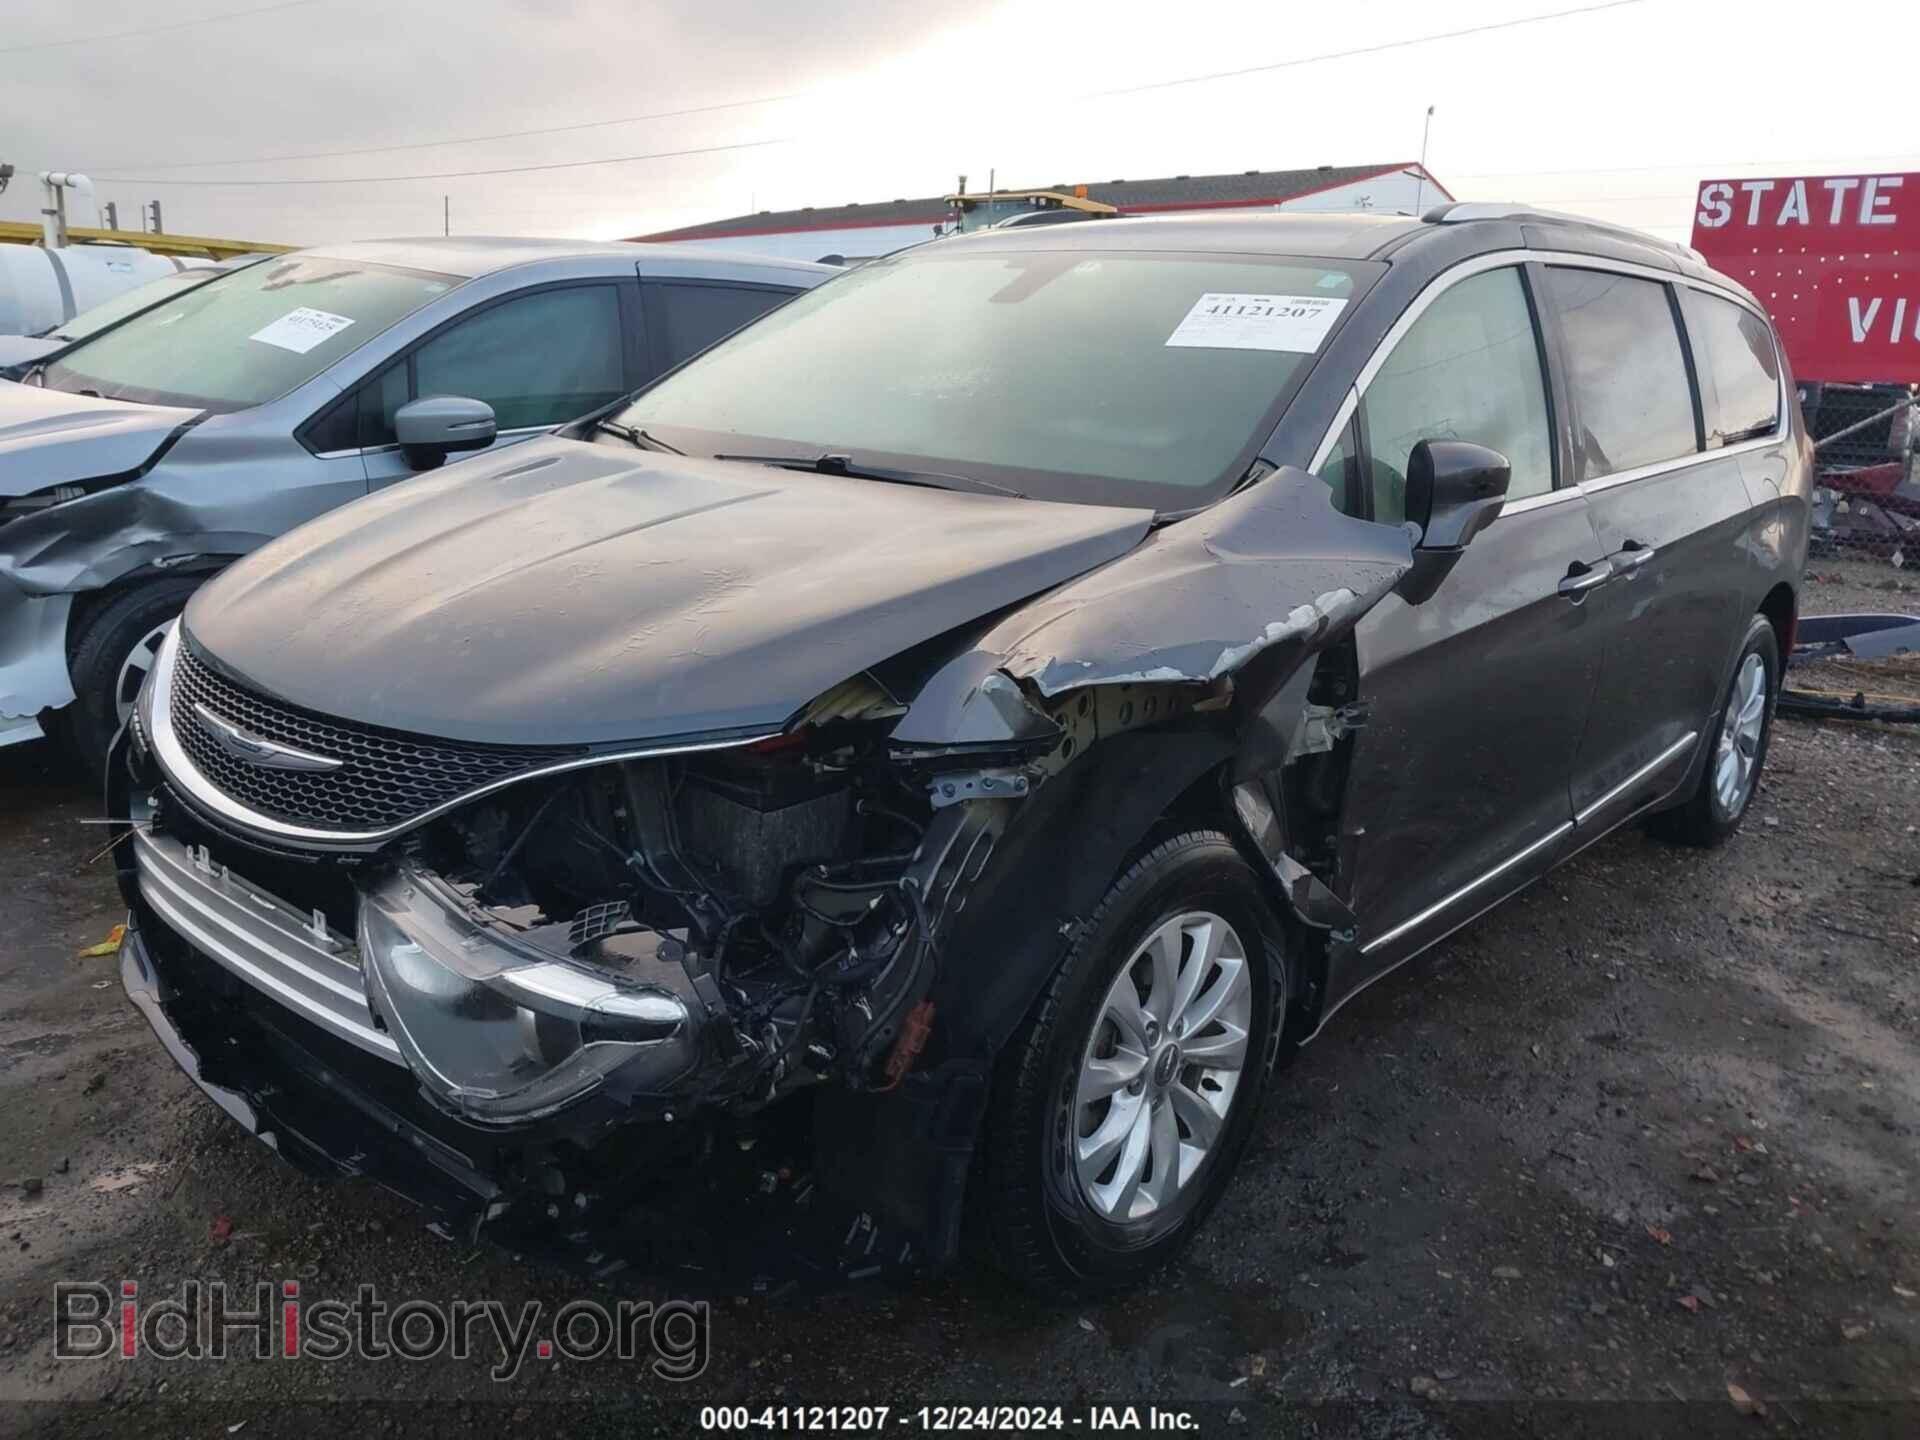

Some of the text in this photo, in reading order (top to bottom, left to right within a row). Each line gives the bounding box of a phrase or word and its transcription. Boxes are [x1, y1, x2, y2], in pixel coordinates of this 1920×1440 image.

[1698, 176, 1904, 228] STATE
[1206, 304, 1323, 320] 41121207
[1848, 296, 1920, 344] VI
